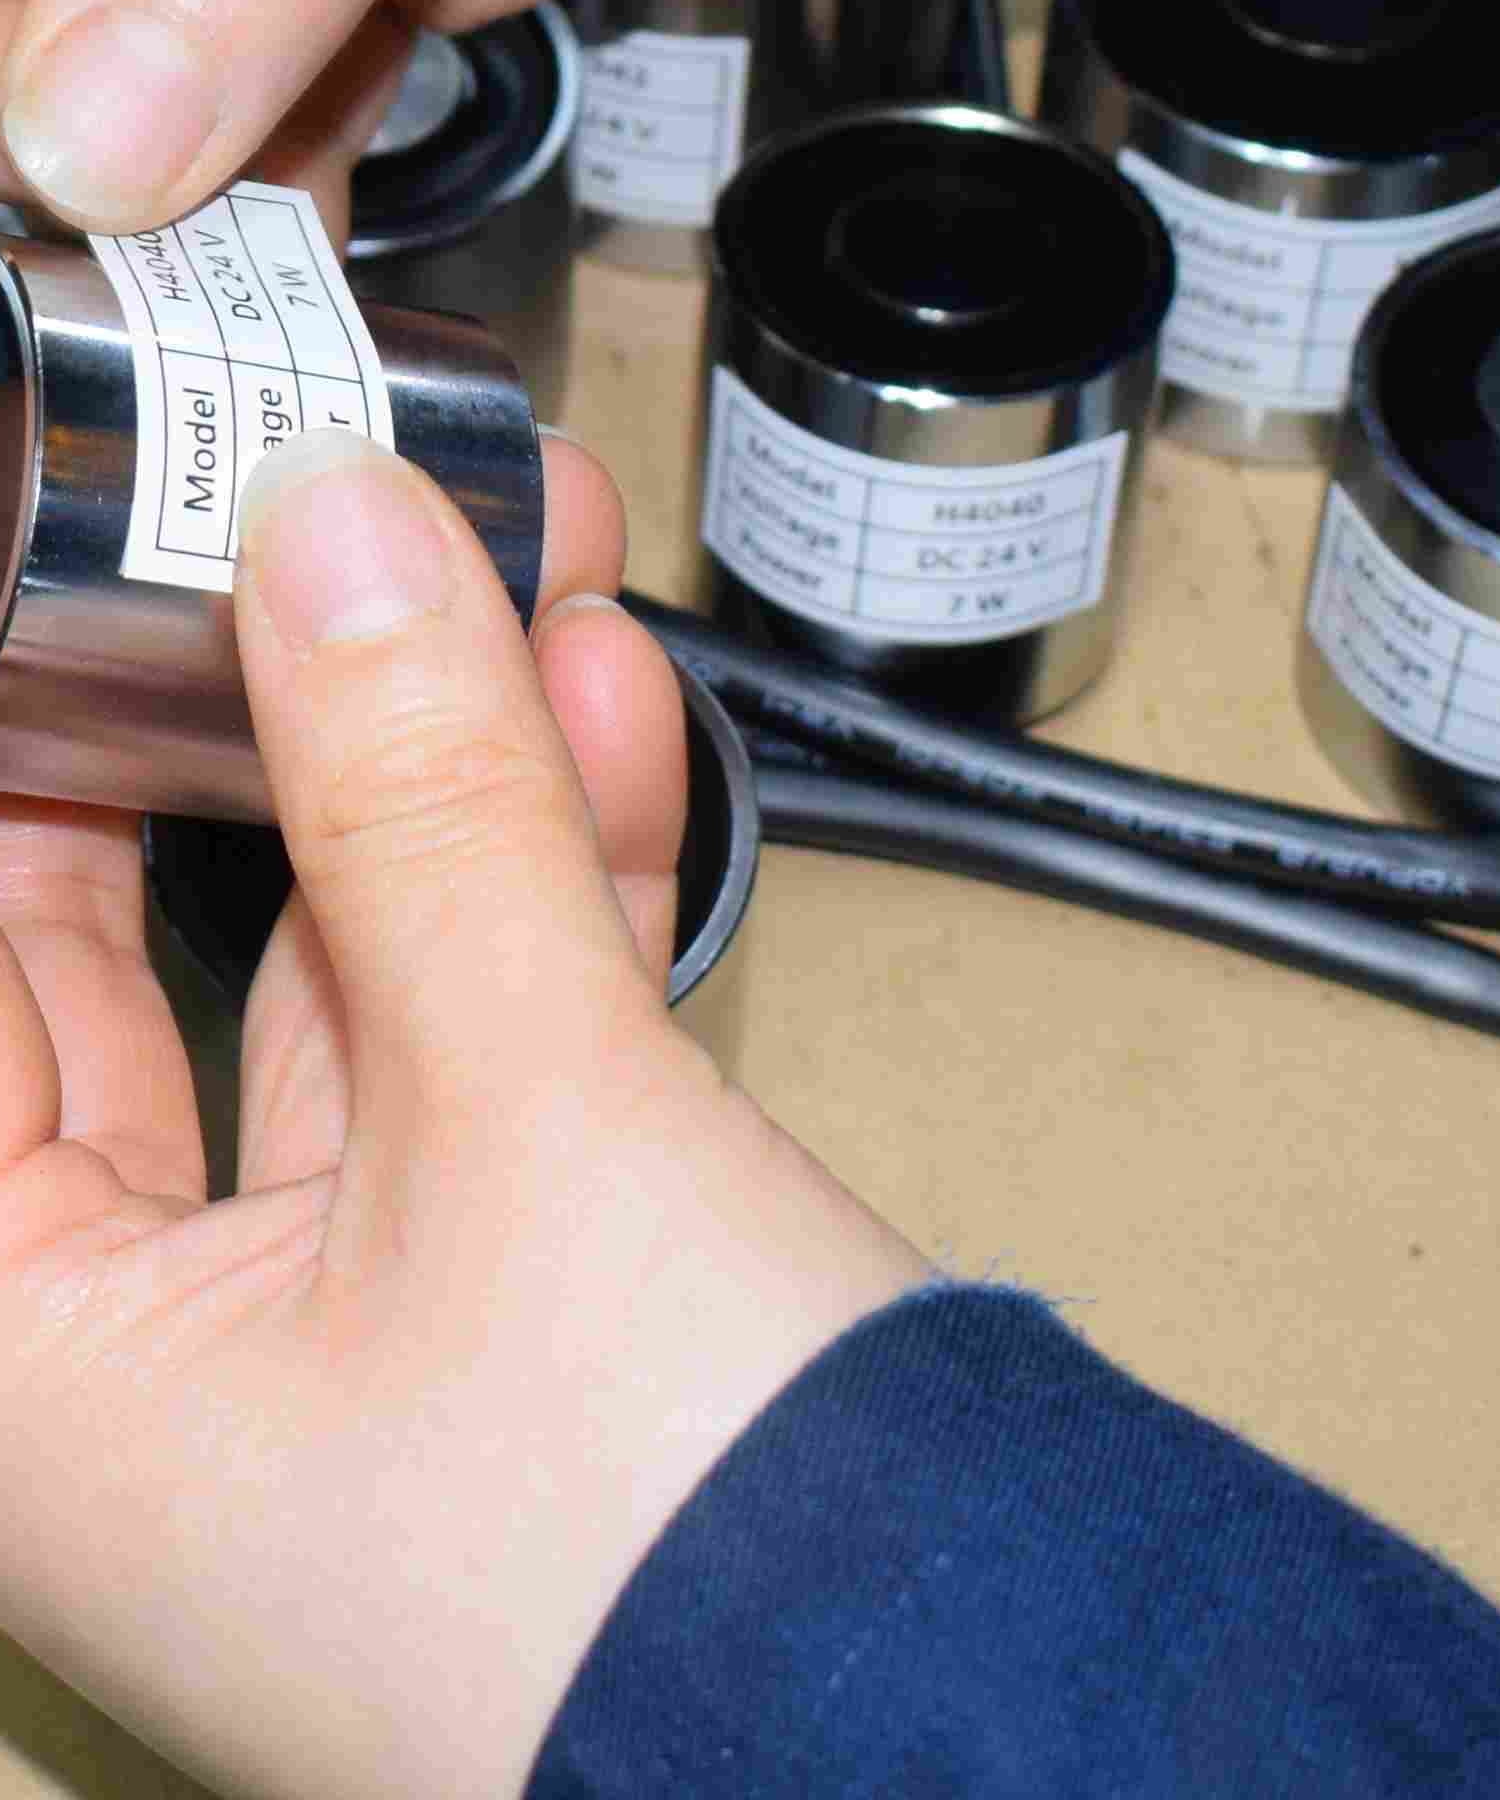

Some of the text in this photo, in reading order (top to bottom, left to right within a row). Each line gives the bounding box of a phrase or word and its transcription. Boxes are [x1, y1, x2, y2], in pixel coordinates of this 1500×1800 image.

[195, 230, 262, 321] DC 24 V
[273, 264, 319, 308] 7 W
[136, 232, 216, 513] Model H4040
[747, 434, 1046, 522] Model H4040
[917, 546, 967, 570] DC
[977, 540, 1017, 569] 24
